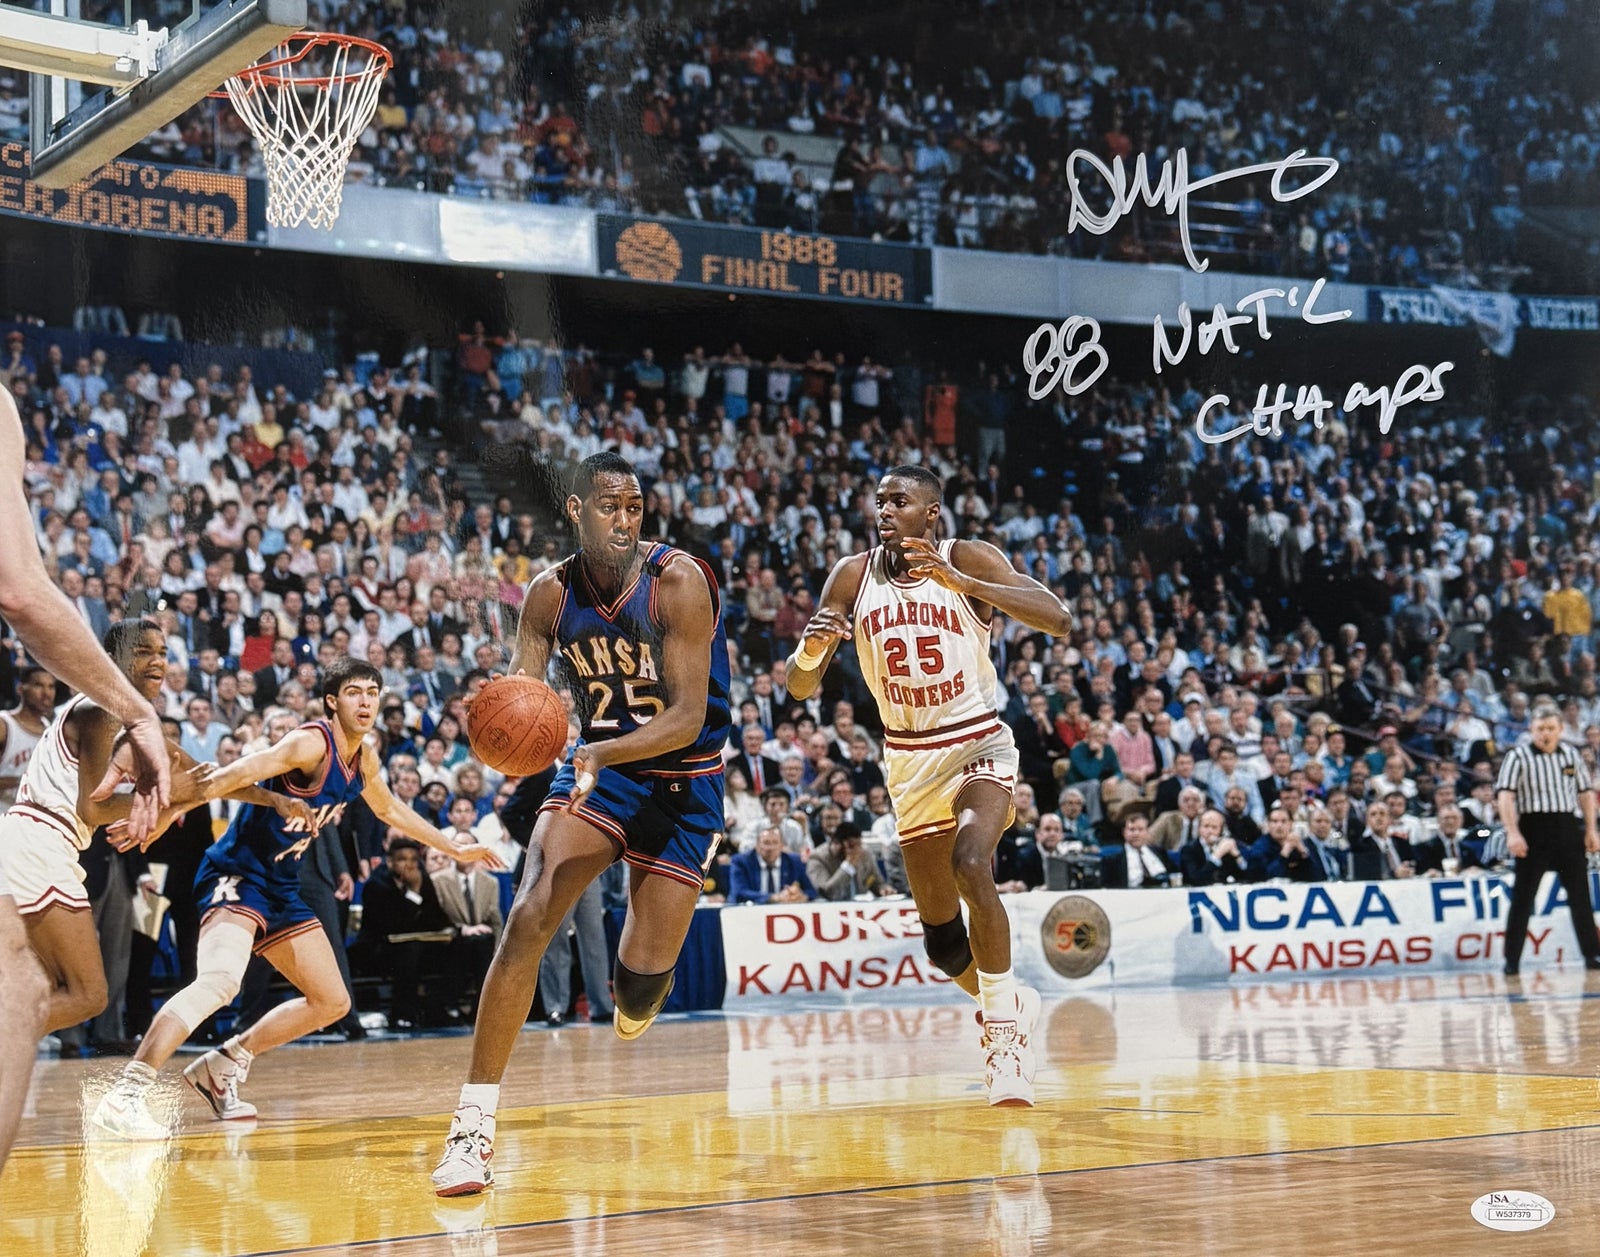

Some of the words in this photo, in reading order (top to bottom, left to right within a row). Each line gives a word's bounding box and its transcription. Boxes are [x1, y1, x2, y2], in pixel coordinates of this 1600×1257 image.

[81, 190, 226, 238] ARENA
[760, 231, 837, 266] 1988
[702, 254, 799, 292] FINAL
[818, 267, 904, 301] FOUR
[1023, 315, 1109, 400] 88
[861, 602, 965, 643] OKLAHOMA
[883, 635, 945, 677] 25
[588, 678, 665, 730] 25
[880, 670, 966, 709] SOONERS
[1188, 883, 1401, 934] NCAA
[1229, 936, 1433, 974] KANSAS
